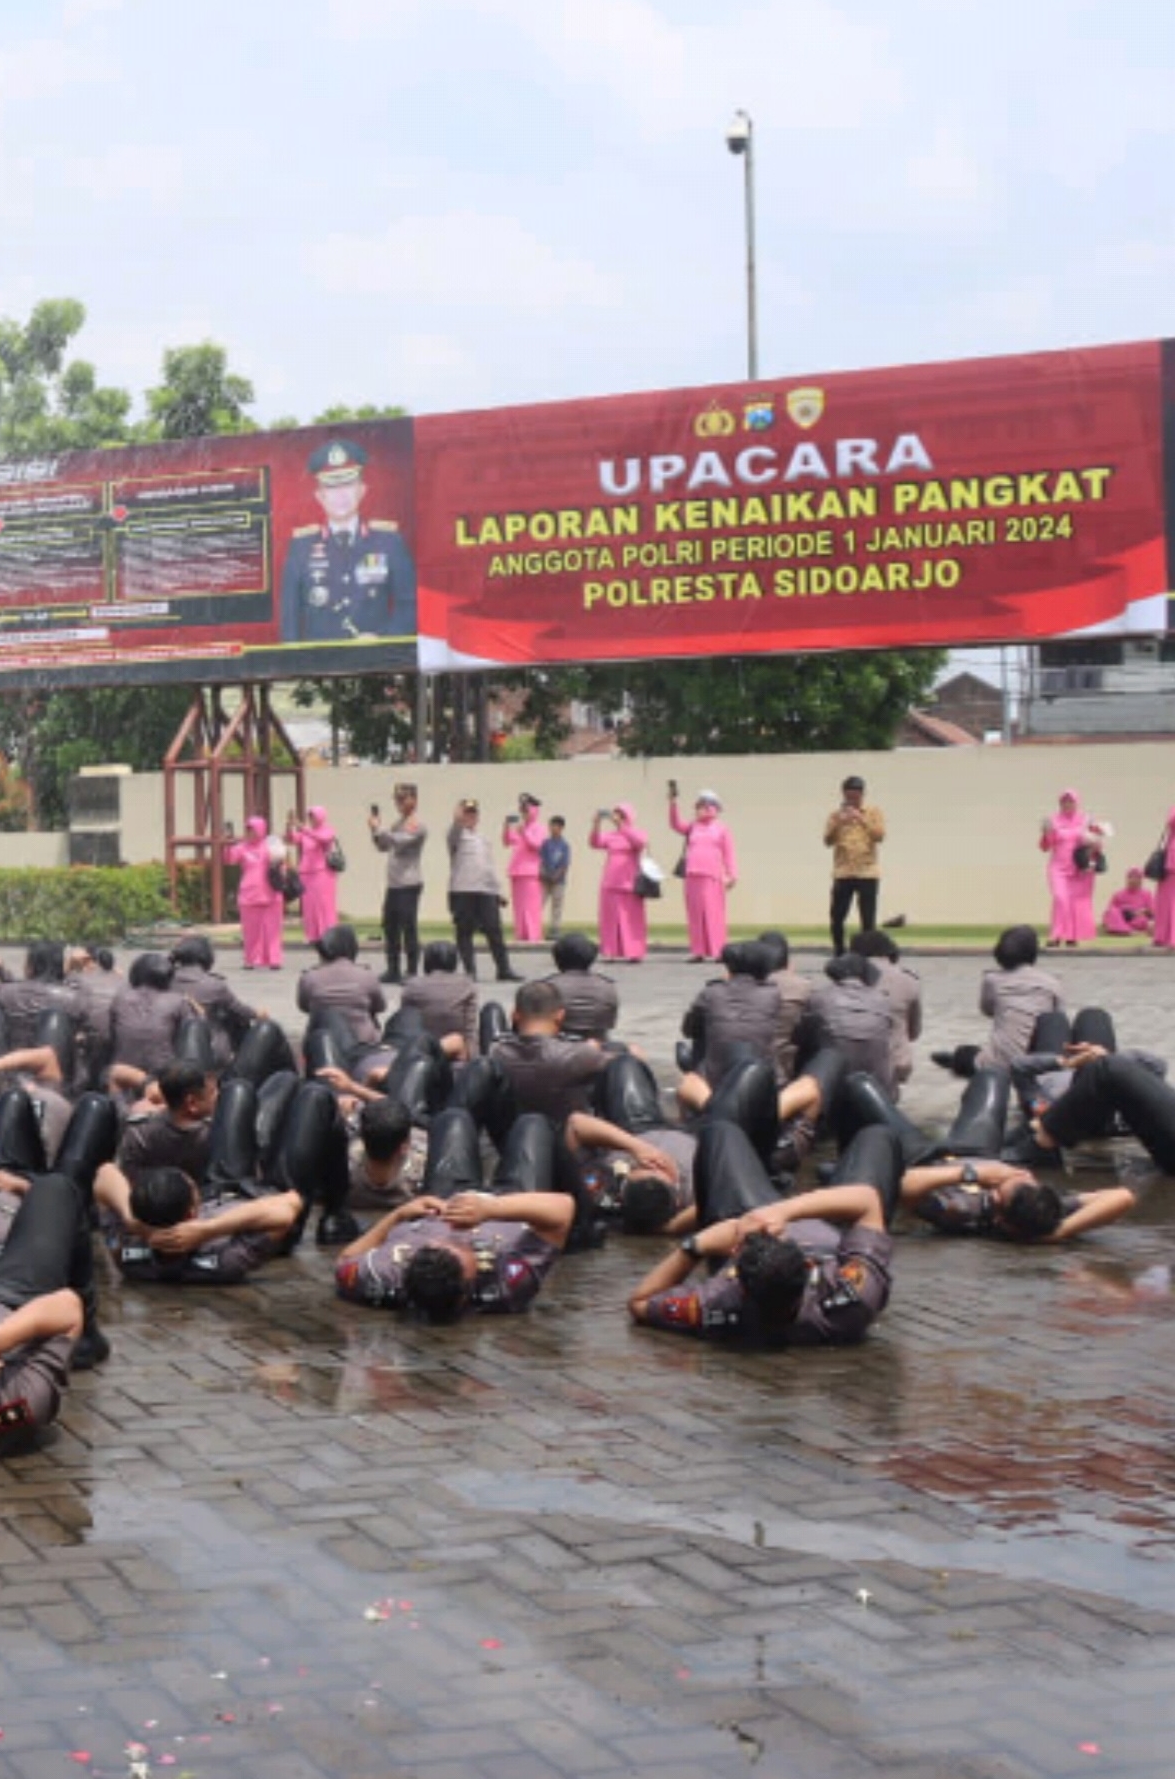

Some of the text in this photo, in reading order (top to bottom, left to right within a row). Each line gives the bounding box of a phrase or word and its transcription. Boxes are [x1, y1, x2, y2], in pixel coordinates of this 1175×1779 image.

[599, 433, 933, 496] UPACARA
[455, 468, 1112, 547] LAPORAN KENAIKAN PANGKAT
[488, 514, 1072, 576] ANGGOTA POLRI PERIODE 1 JANUARI 2024
[583, 559, 960, 610] POLRESTA SIDOARJO
